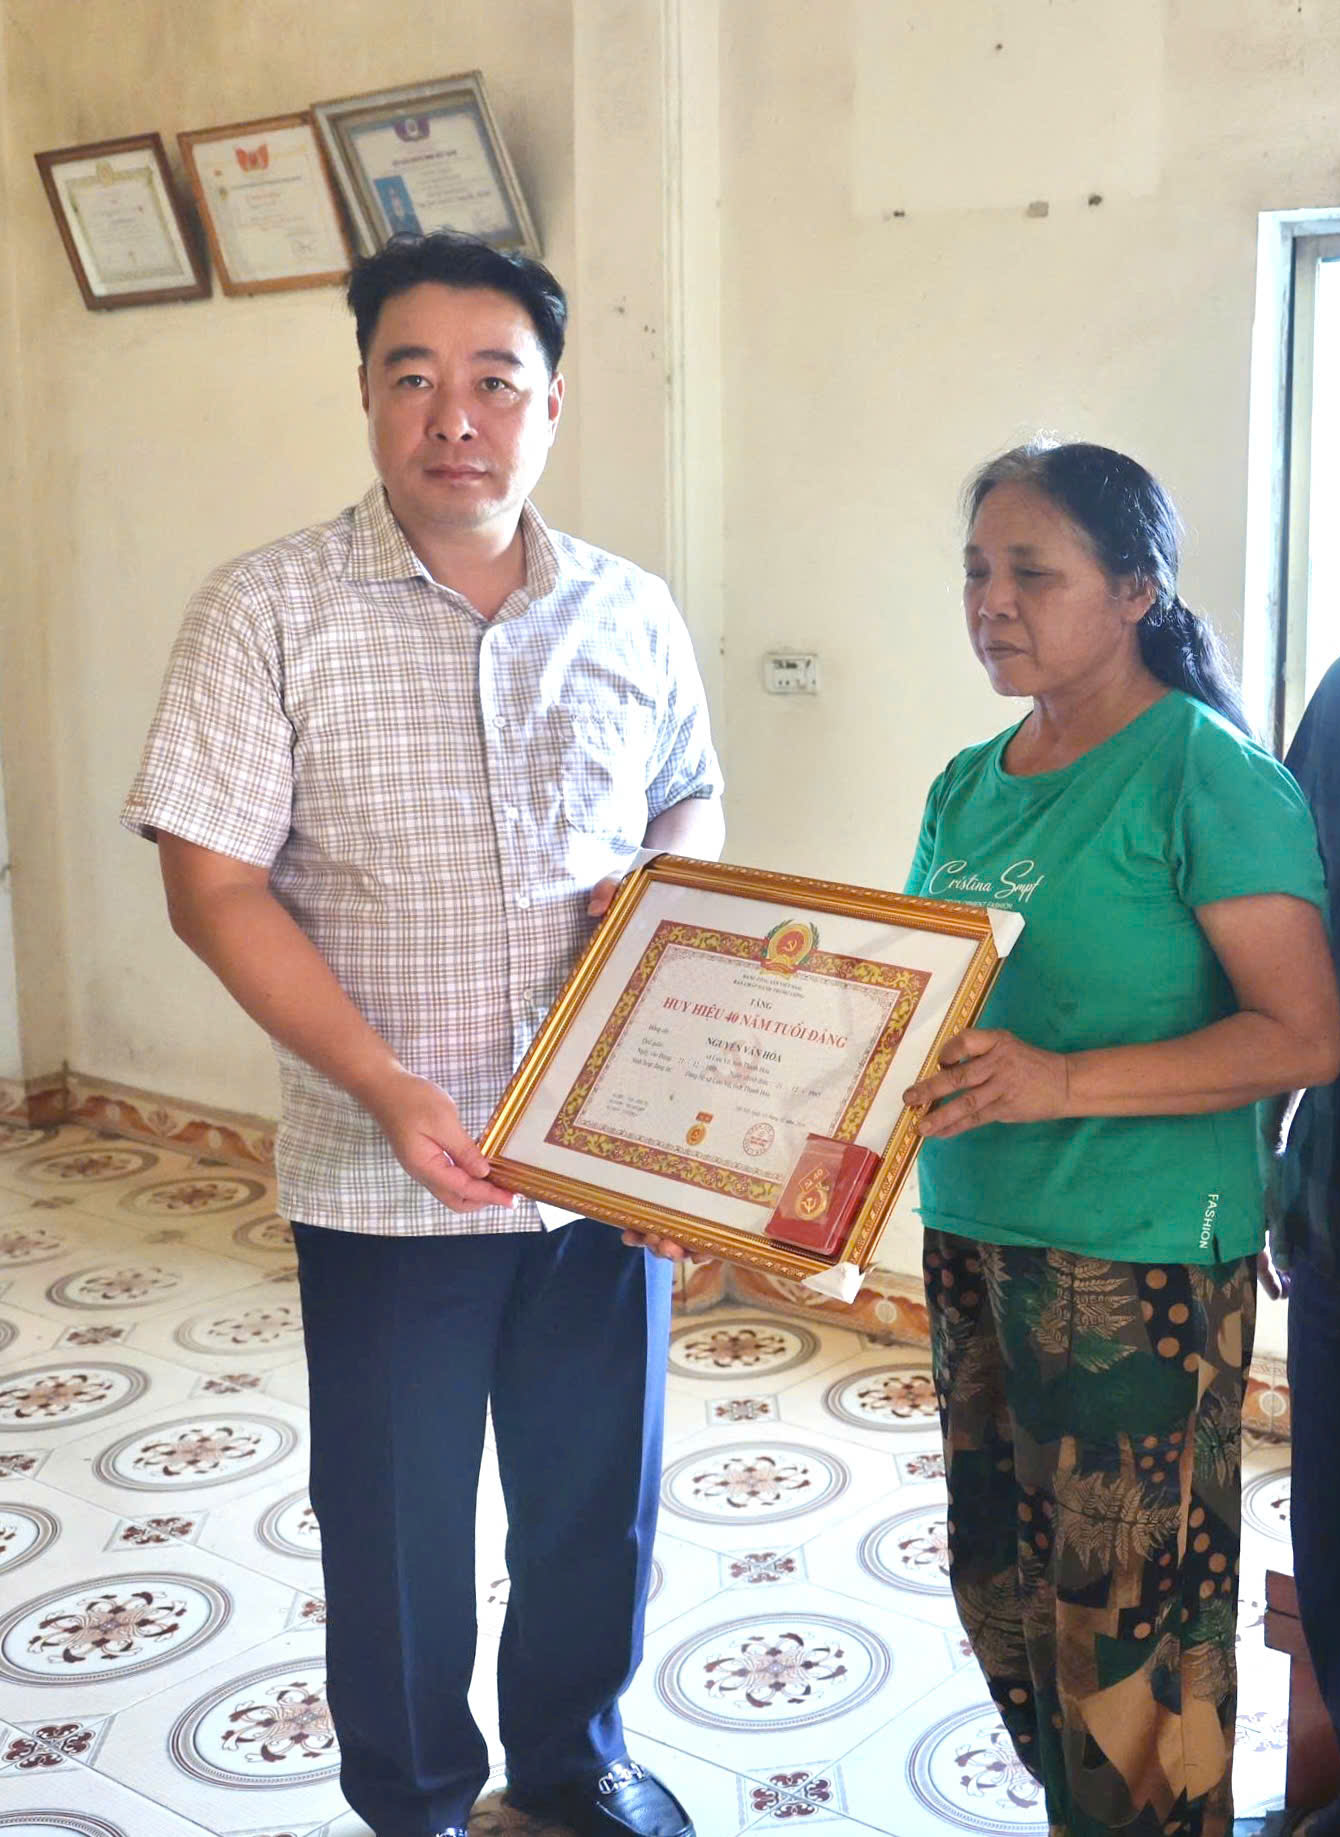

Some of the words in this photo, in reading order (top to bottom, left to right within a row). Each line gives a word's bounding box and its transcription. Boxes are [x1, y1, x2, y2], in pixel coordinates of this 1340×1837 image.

[929, 859, 993, 895] Cristina
[663, 997, 691, 1013] HUY
[692, 1004, 725, 1021] HIỆU
[725, 1011, 739, 1023] 40
[740, 1014, 772, 1031] NĂM
[774, 1020, 808, 1039] TUỔI
[808, 1028, 848, 1048] ĐẢNG
[1199, 1194, 1220, 1249] FASHION
